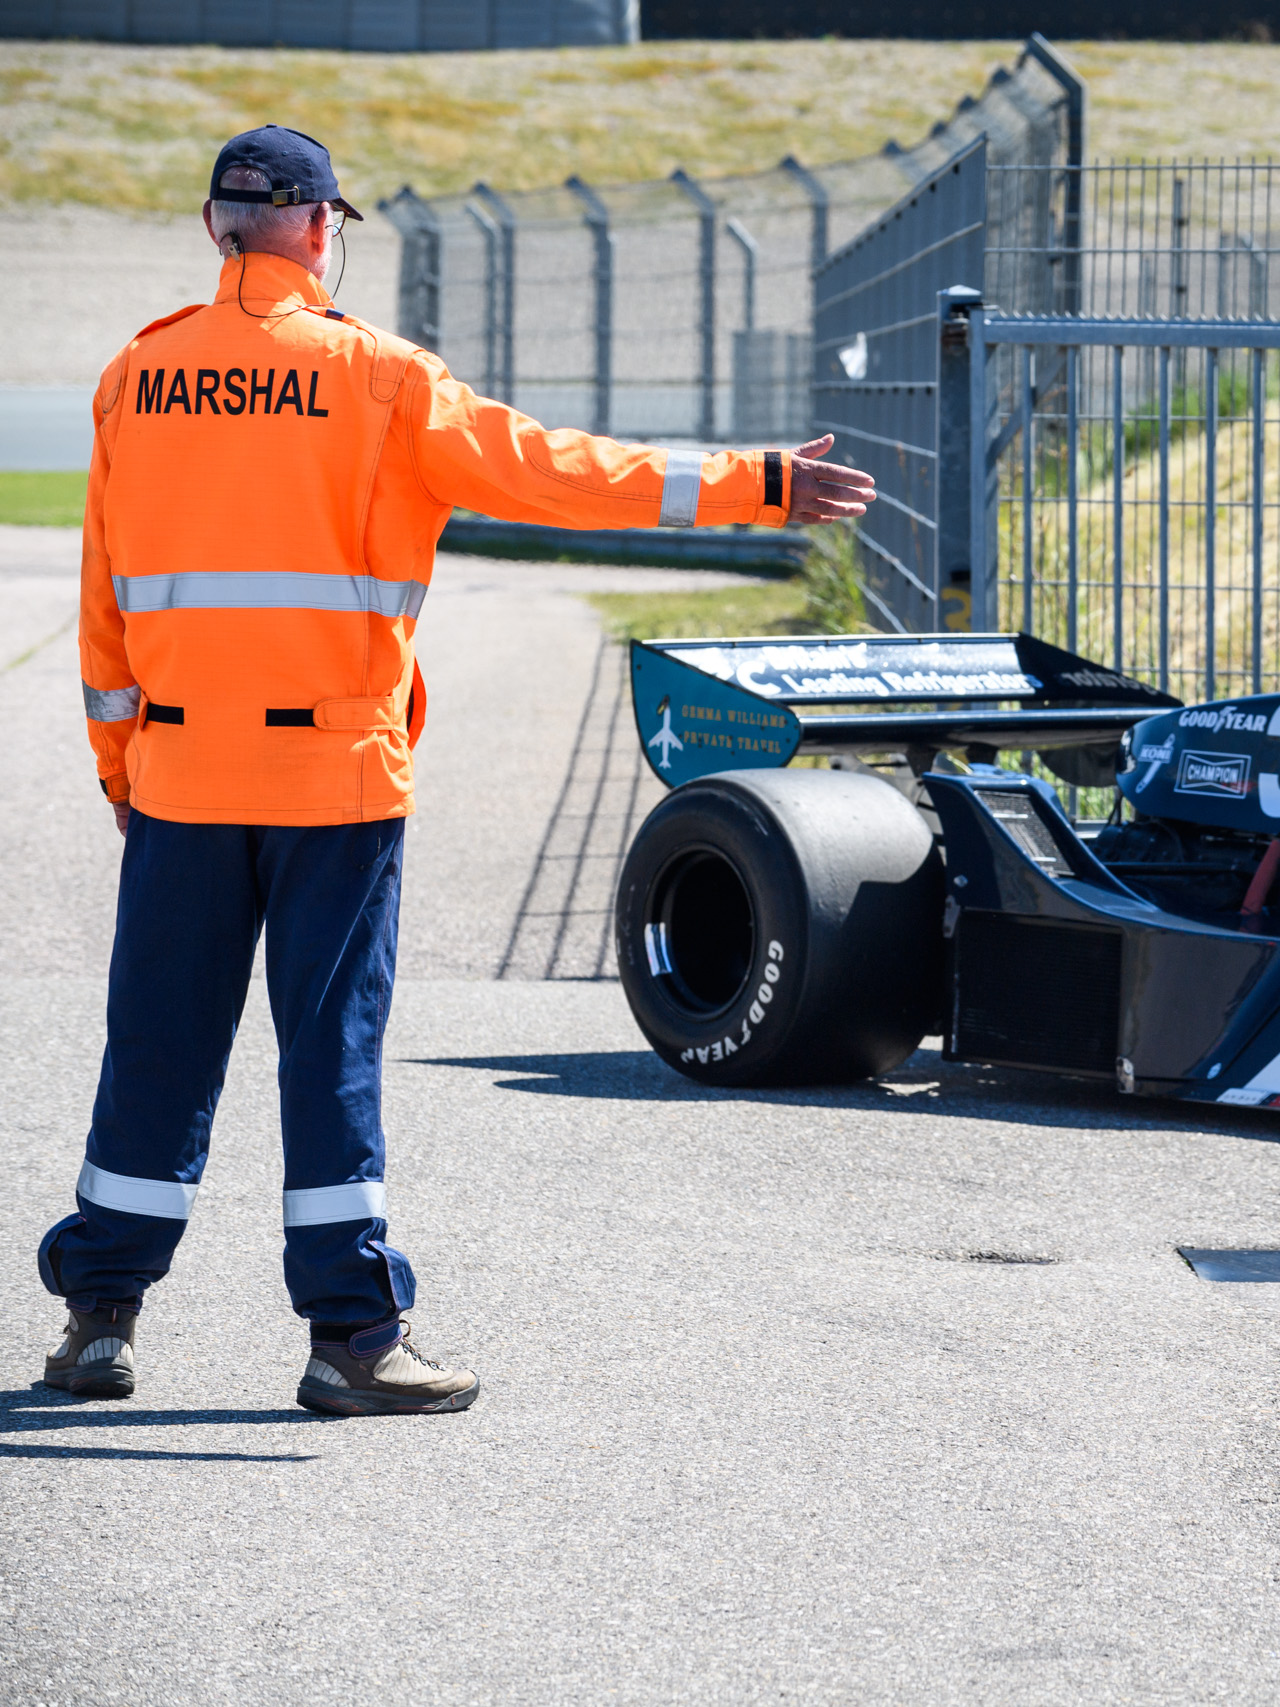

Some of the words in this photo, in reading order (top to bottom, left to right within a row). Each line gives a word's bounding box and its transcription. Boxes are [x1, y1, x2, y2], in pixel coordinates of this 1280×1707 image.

[136, 367, 329, 418] MARSHAL
[781, 672, 889, 697] Leading
[682, 705, 722, 721] GEMMA
[727, 710, 786, 729] WILLIAMS
[1179, 706, 1268, 734] GOODYEAR
[683, 730, 733, 748] PRIVATE
[738, 737, 781, 754] TRAVEL
[1140, 746, 1172, 761] KONI
[1187, 763, 1240, 785] CHAMPION
